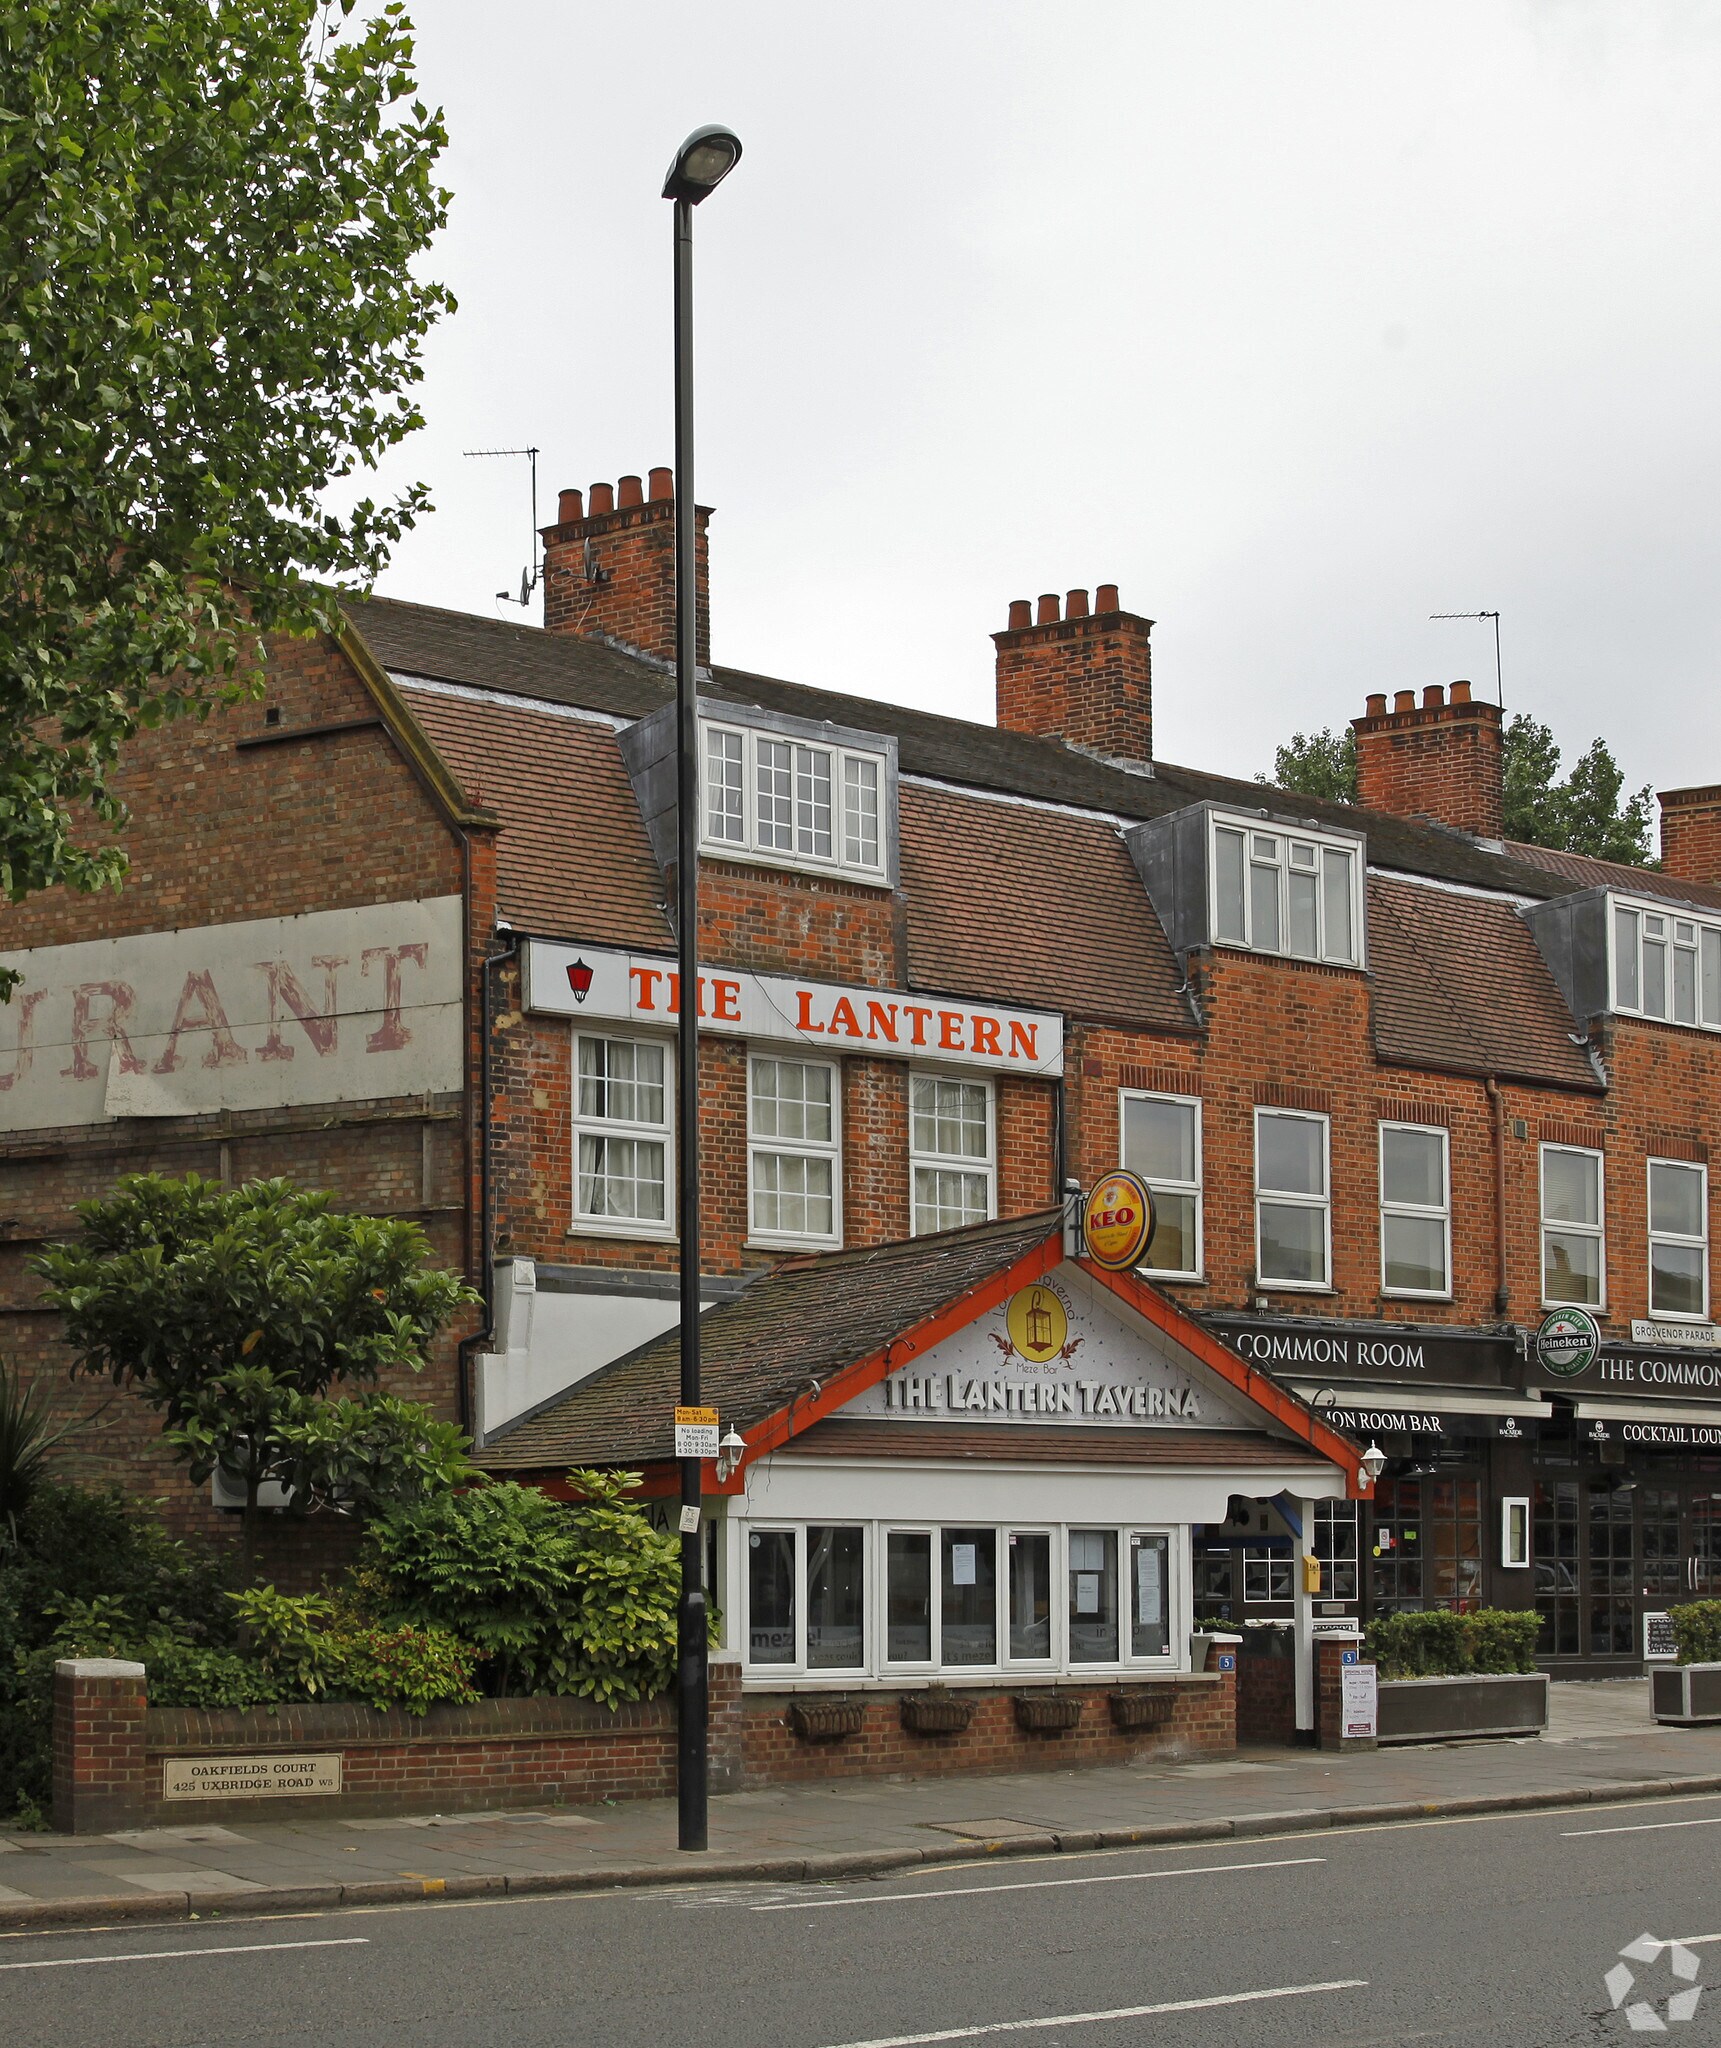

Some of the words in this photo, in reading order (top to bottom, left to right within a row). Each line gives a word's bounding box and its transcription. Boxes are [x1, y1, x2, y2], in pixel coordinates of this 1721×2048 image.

[629, 967, 741, 1022] THE
[795, 990, 1040, 1061] LANTERN
[1090, 1207, 1135, 1231] KEO
[1635, 1326, 1684, 1340] GROSVENOR
[1685, 1330, 1716, 1342] PARADE
[1236, 1334, 1348, 1364] COMMON
[1357, 1342, 1426, 1369] ROOM
[1540, 1336, 1588, 1350] Heineken
[1016, 1362, 1039, 1374] Meze
[1043, 1363, 1059, 1375] Bar
[1596, 1358, 1635, 1381] THE
[888, 1379, 941, 1408] THE
[948, 1374, 1074, 1414] LANTERN
[1076, 1380, 1200, 1418] TAVERNA
[1358, 1412, 1407, 1431] ROOM
[1409, 1415, 1443, 1432] BAR
[1623, 1424, 1689, 1443] COCKTAIL
[1224, 1658, 1230, 1668] 5
[1346, 1653, 1352, 1663] 5
[191, 1764, 268, 1776] OAKFIELDS
[273, 1763, 317, 1773] COURT
[173, 1781, 196, 1792] 425
[202, 1779, 271, 1791] UXBRIDGE
[277, 1777, 314, 1788] ROAD
[319, 1778, 334, 1787] W5
